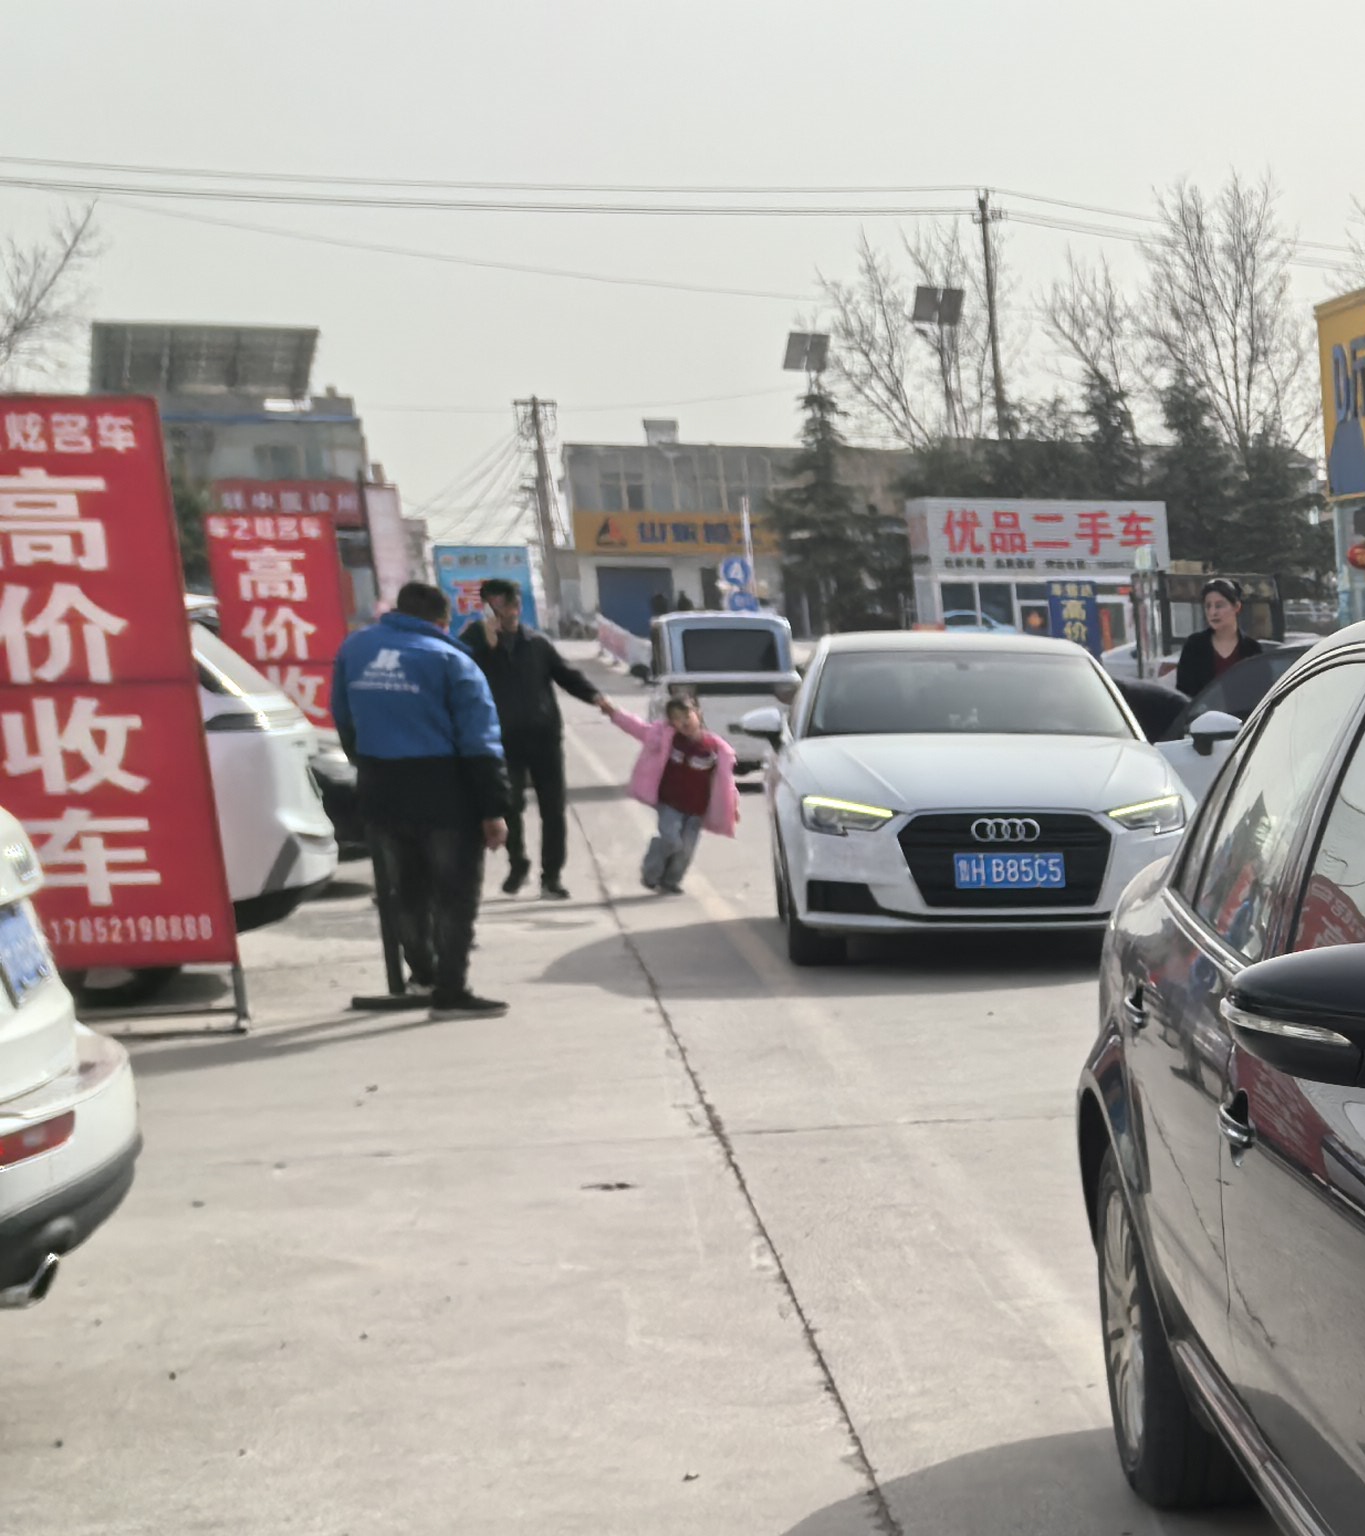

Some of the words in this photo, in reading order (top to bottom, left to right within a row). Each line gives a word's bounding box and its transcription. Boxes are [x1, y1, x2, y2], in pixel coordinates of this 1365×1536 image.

[943, 508, 1156, 556] 优品二手车
[0, 467, 162, 907] 高价收车
